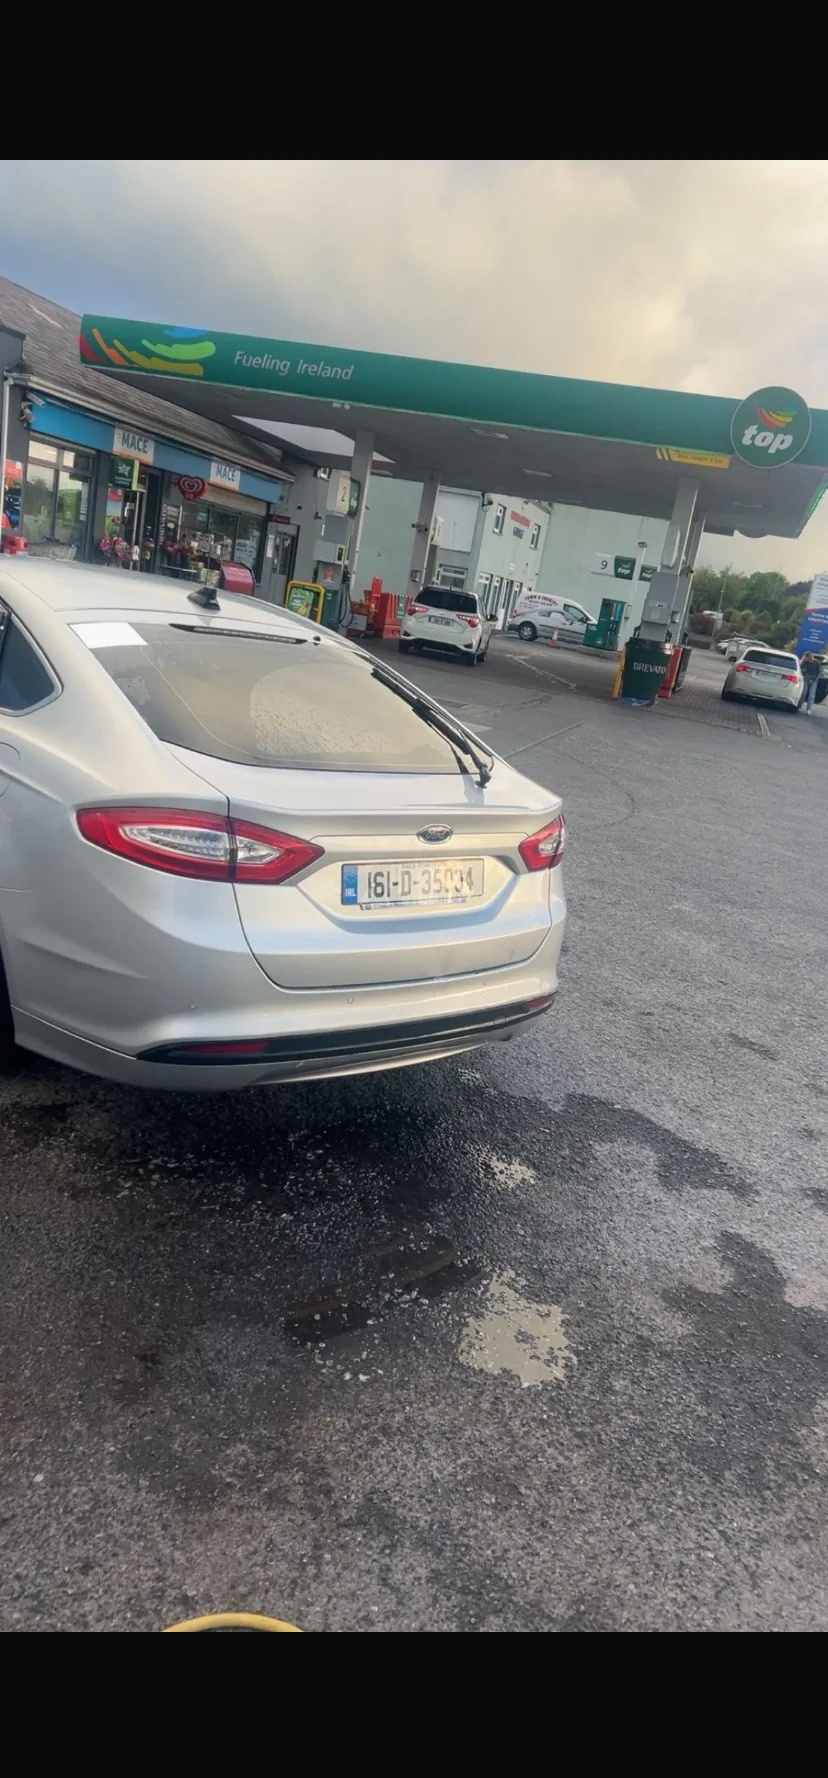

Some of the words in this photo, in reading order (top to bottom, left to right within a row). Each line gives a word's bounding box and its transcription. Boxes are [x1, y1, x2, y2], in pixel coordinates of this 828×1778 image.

[234, 350, 291, 376] Fueling
[296, 359, 354, 380] Ireland
[121, 431, 149, 454] MACE
[742, 424, 793, 454] top
[215, 464, 236, 482] MACE
[341, 487, 347, 502] 2
[600, 560, 608, 569] 9
[617, 567, 631, 575] top
[344, 888, 356, 897] IRL
